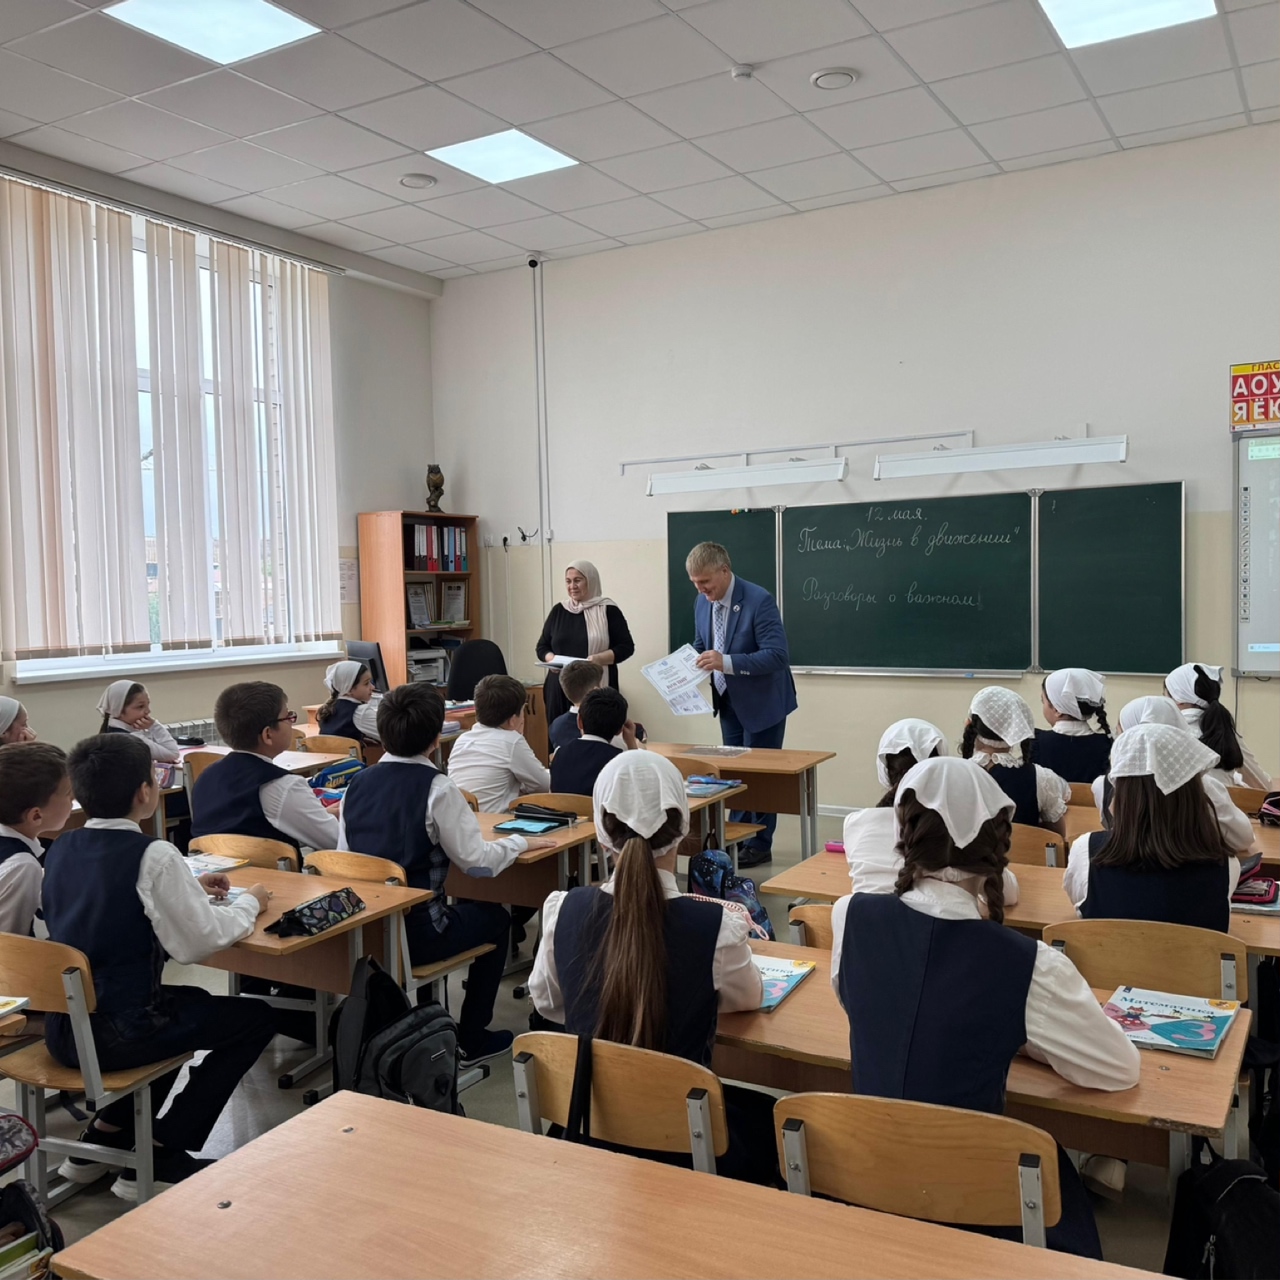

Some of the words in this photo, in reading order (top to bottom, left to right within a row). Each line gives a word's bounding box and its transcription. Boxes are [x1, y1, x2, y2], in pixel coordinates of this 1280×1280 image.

[866, 507, 884, 522] 12
[888, 508, 928, 521] мая.
[798, 527, 847, 552] Тема:
[910, 525, 922, 547] в
[803, 577, 877, 611] Разговоры
[889, 594, 897, 603] о
[1120, 996, 1215, 1015] Математика
[1171, 1020, 1217, 1041] 3
